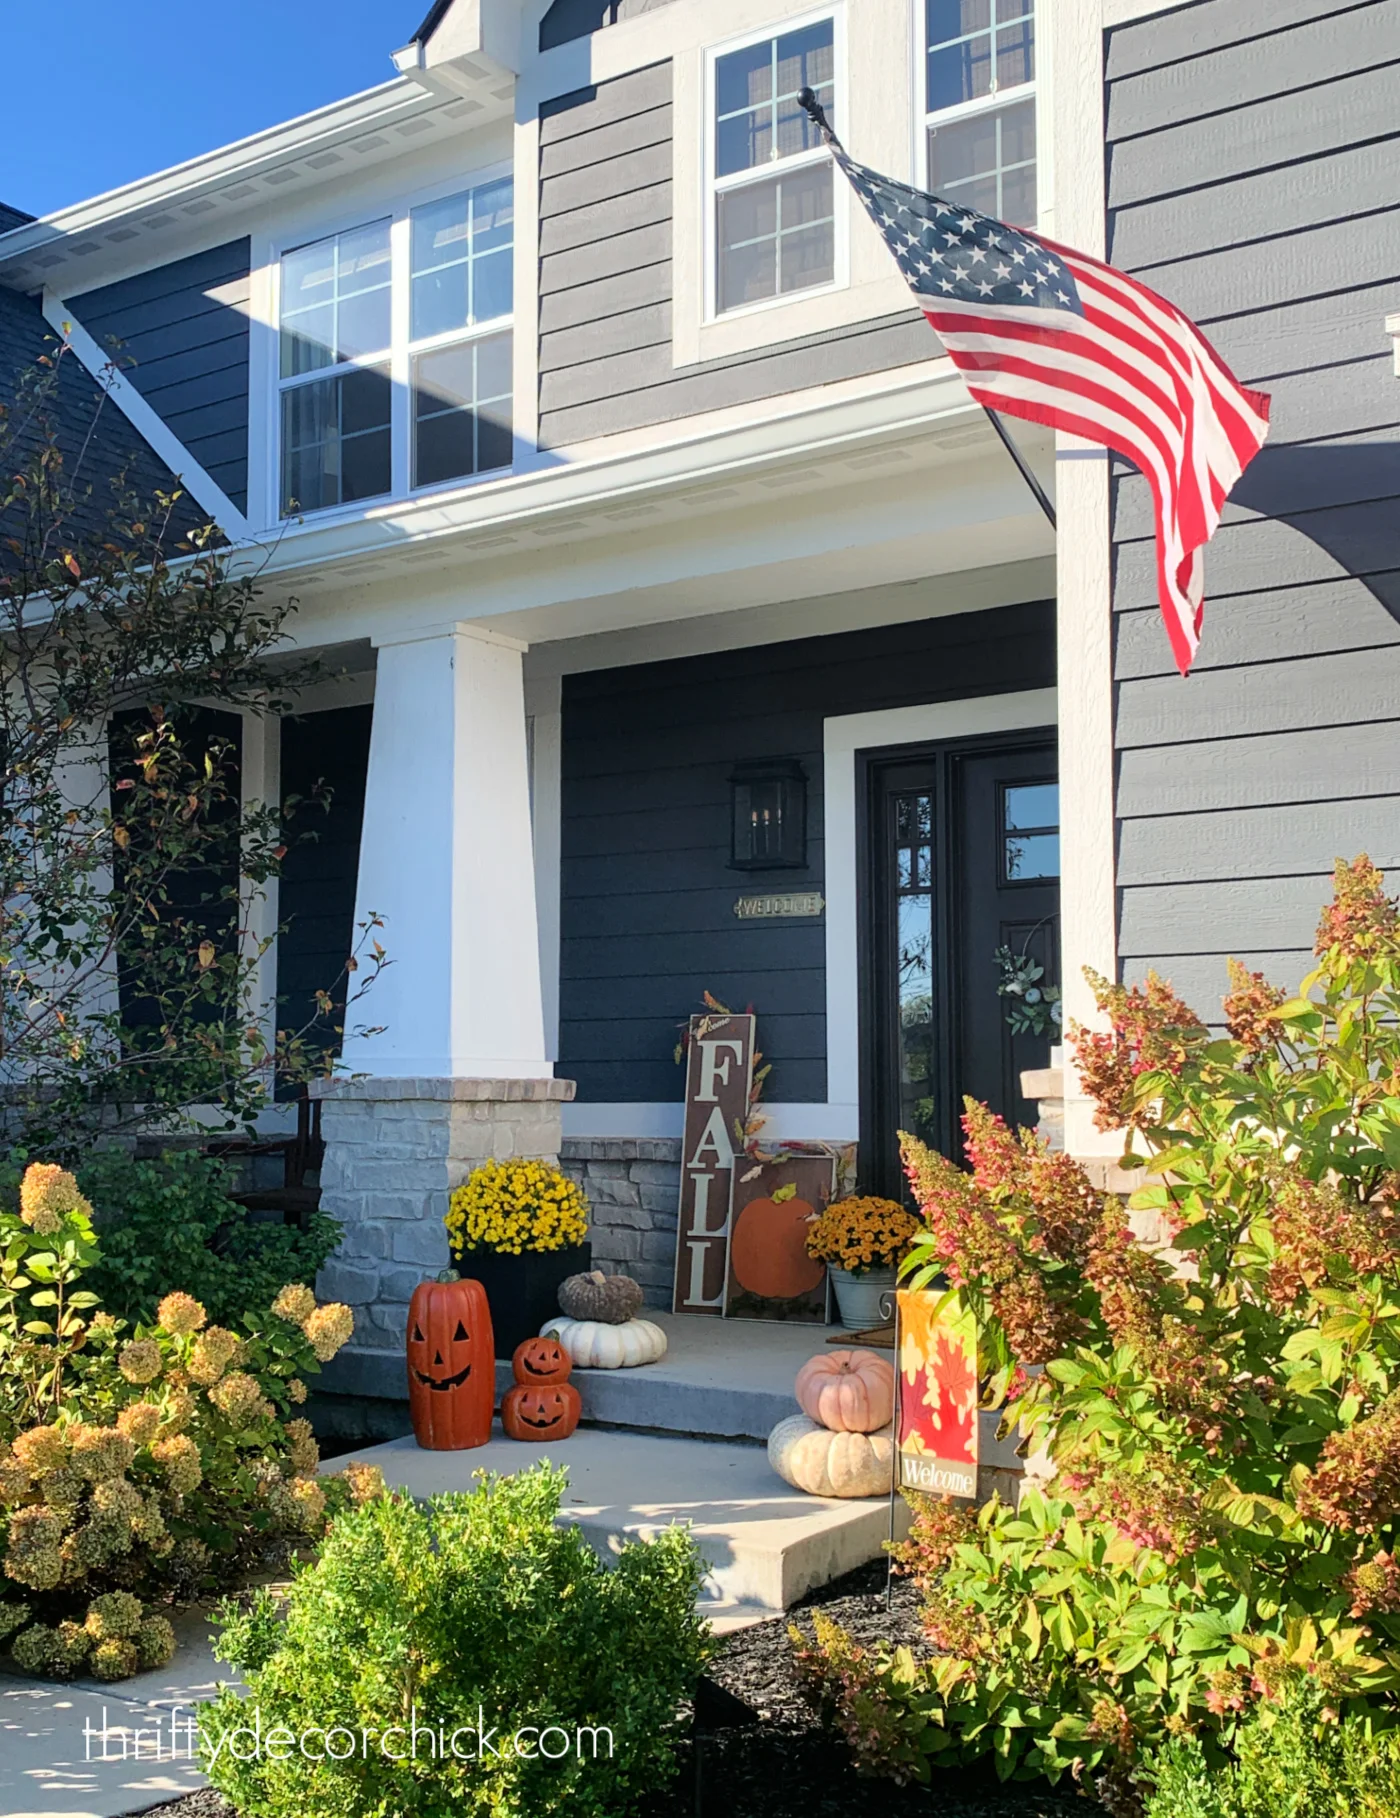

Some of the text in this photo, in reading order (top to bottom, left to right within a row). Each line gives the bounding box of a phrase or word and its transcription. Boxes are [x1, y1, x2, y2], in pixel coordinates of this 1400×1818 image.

[742, 896, 816, 915] WELCOME
[683, 1040, 743, 1306] FALL
[903, 1458, 974, 1494] Welcome
